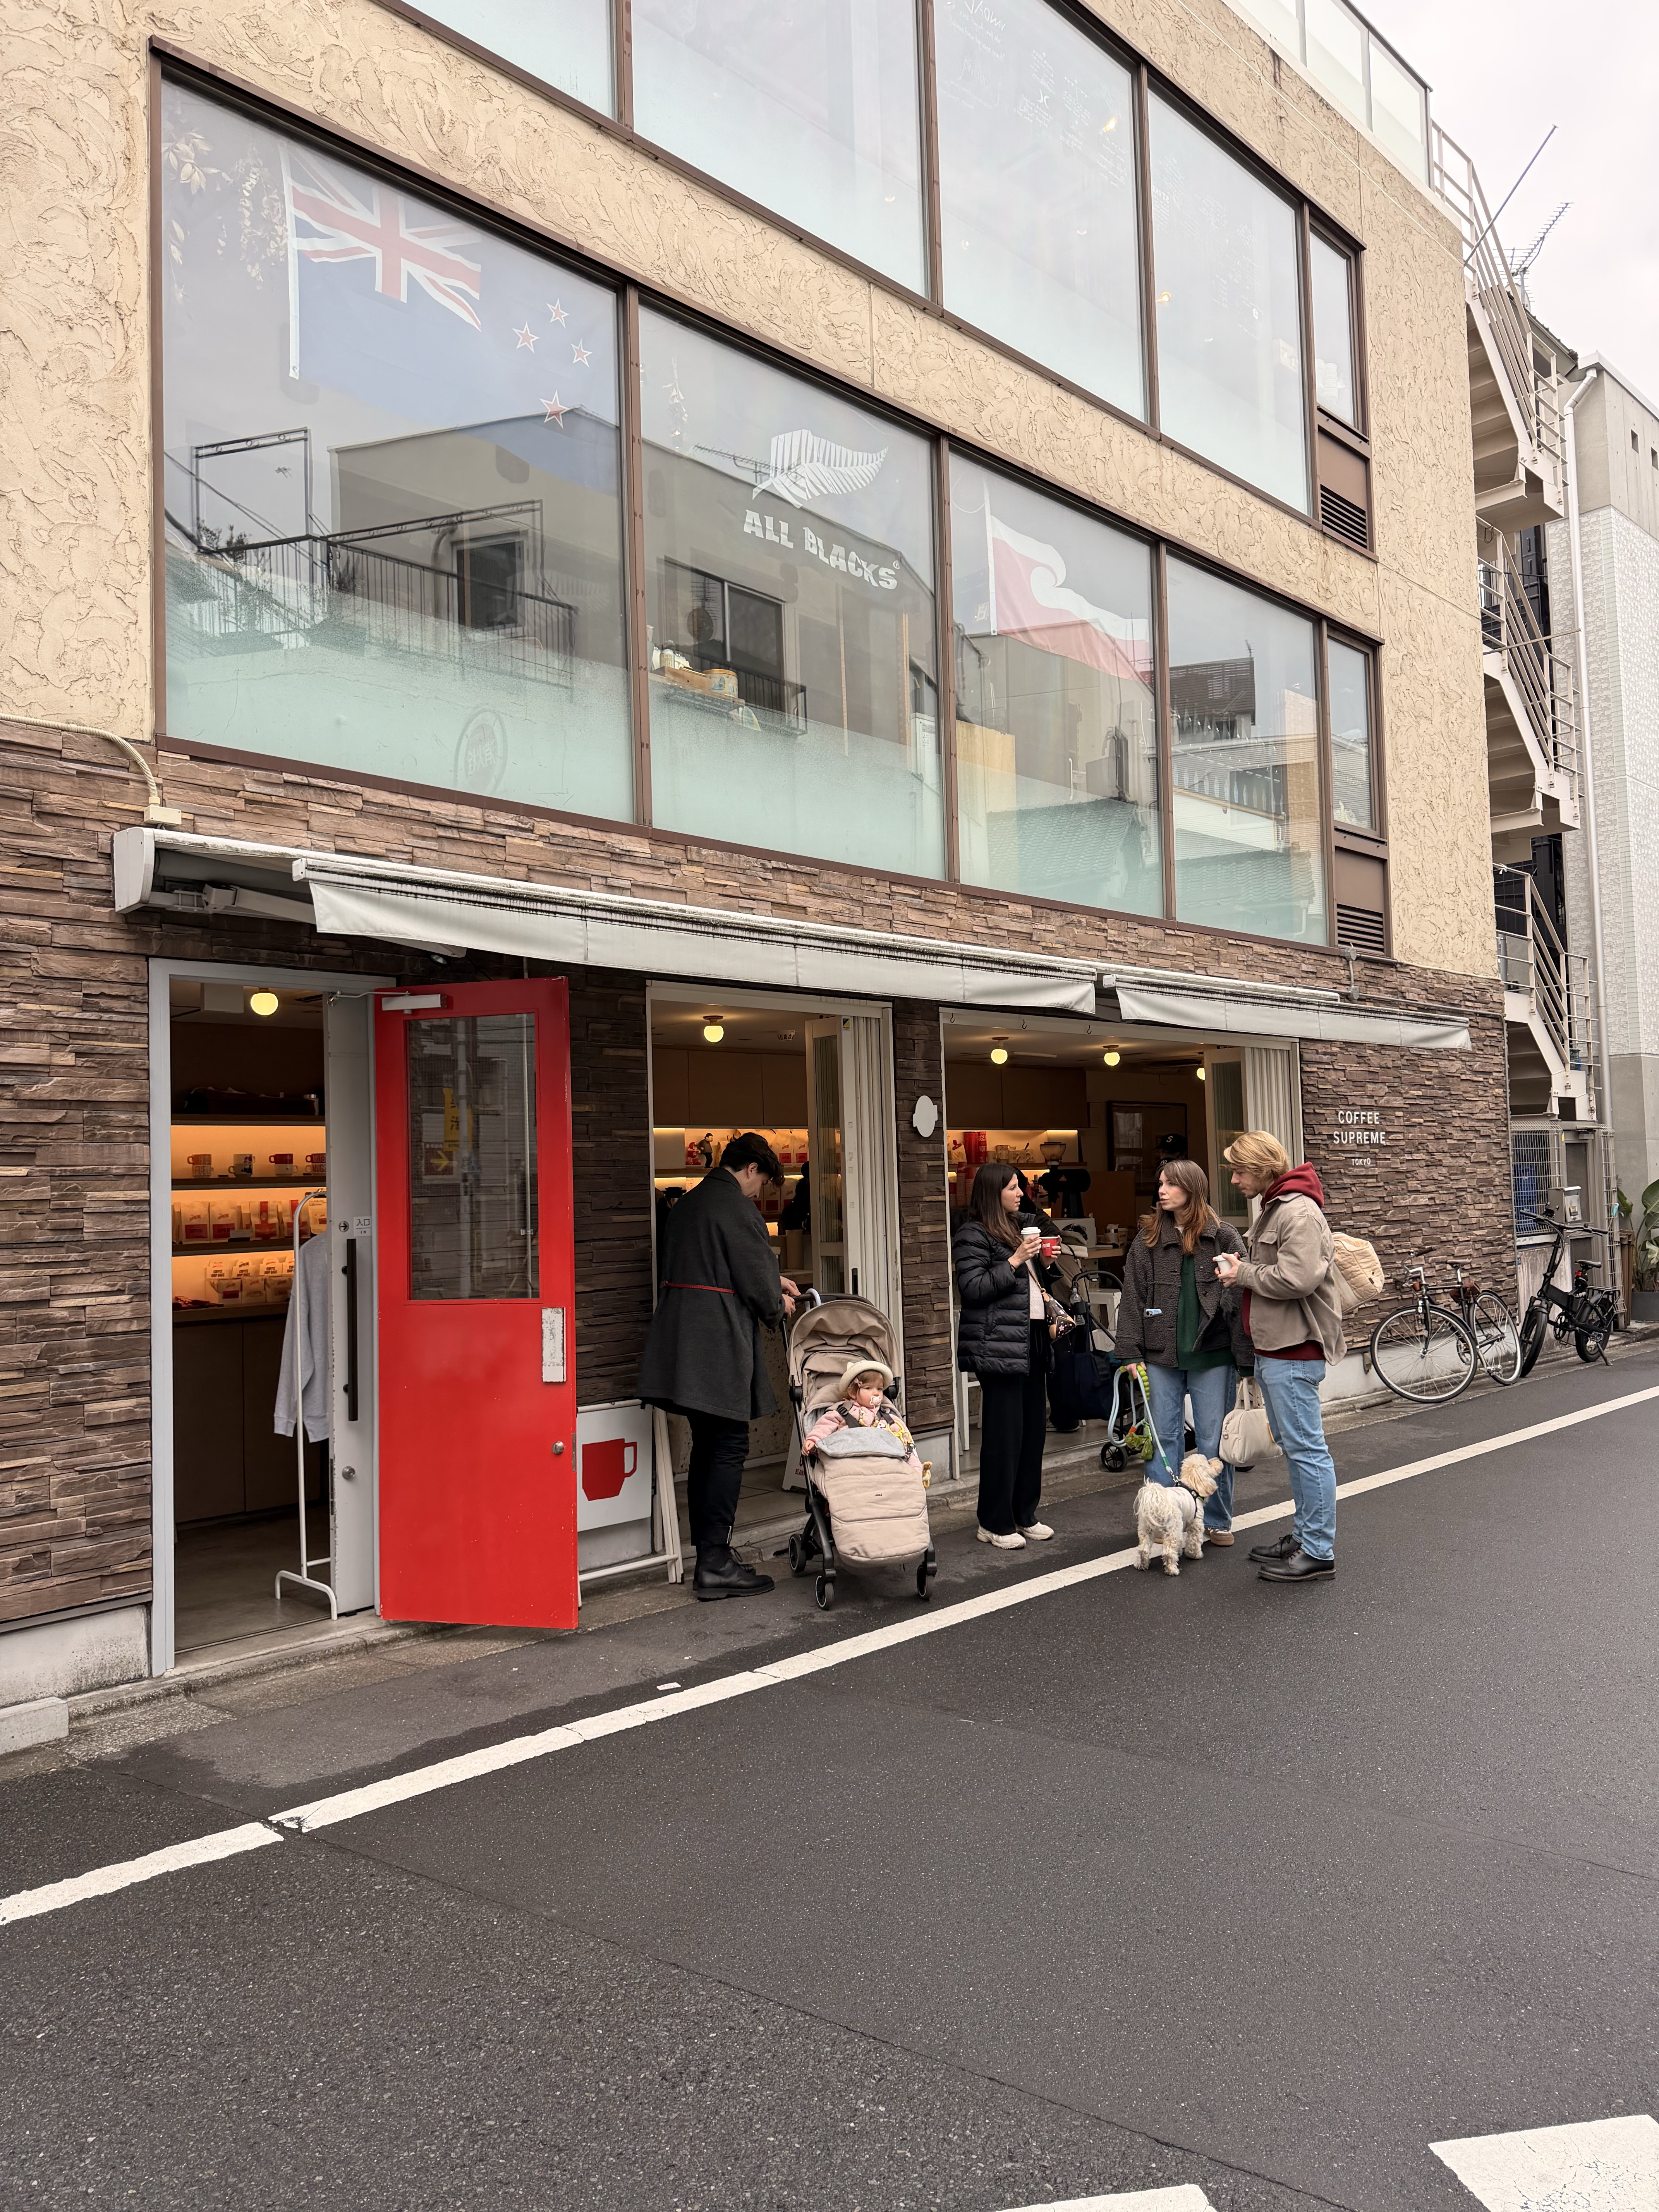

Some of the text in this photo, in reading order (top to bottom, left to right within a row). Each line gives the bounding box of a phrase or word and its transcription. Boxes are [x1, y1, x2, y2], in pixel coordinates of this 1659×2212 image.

[744, 510, 793, 549] ALL
[1338, 1111, 1380, 1125] COFFEE
[1333, 1131, 1386, 1144] SUPREME
[1352, 1158, 1371, 1166] TOKYO
